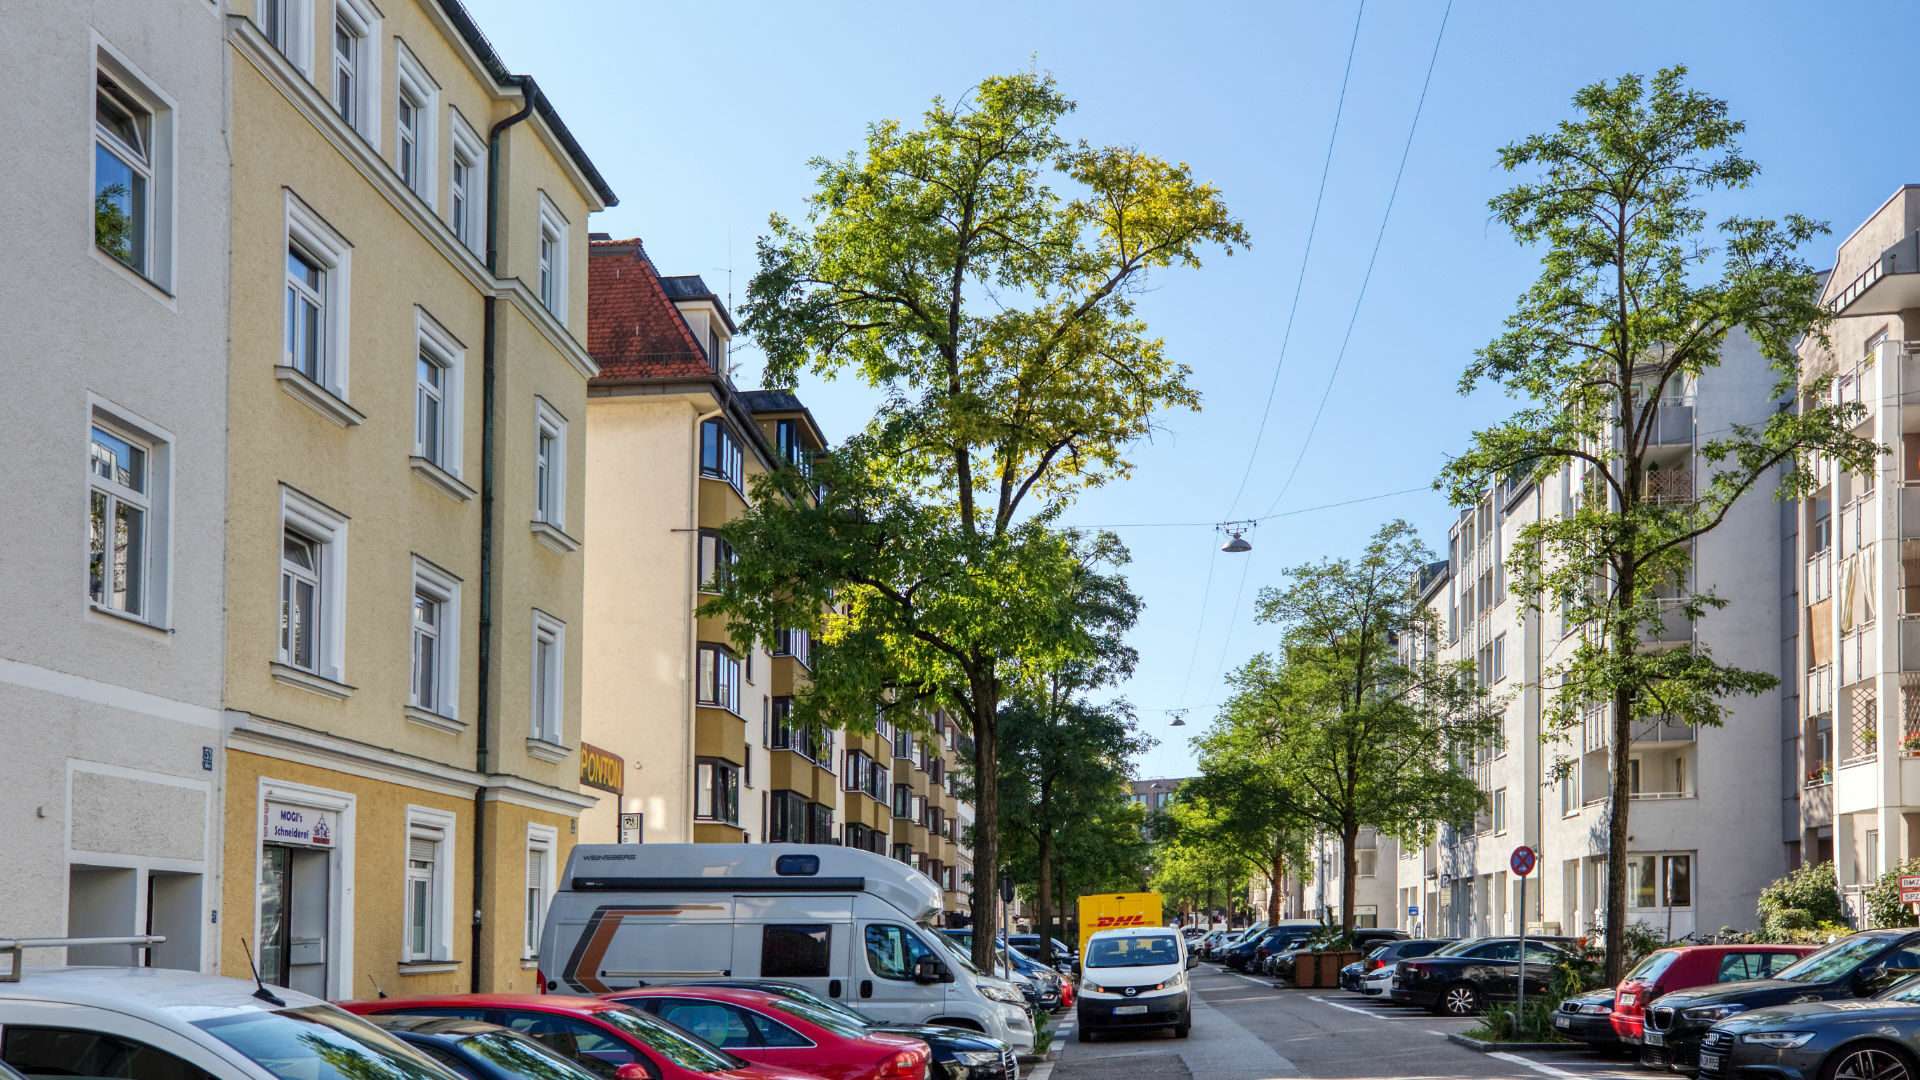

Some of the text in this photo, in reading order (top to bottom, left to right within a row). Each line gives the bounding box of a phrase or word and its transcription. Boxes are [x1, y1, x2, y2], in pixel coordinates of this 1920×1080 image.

[581, 750, 621, 787] PONTON
[274, 825, 309, 840] Schneiderei
[1097, 915, 1144, 927] DHL
